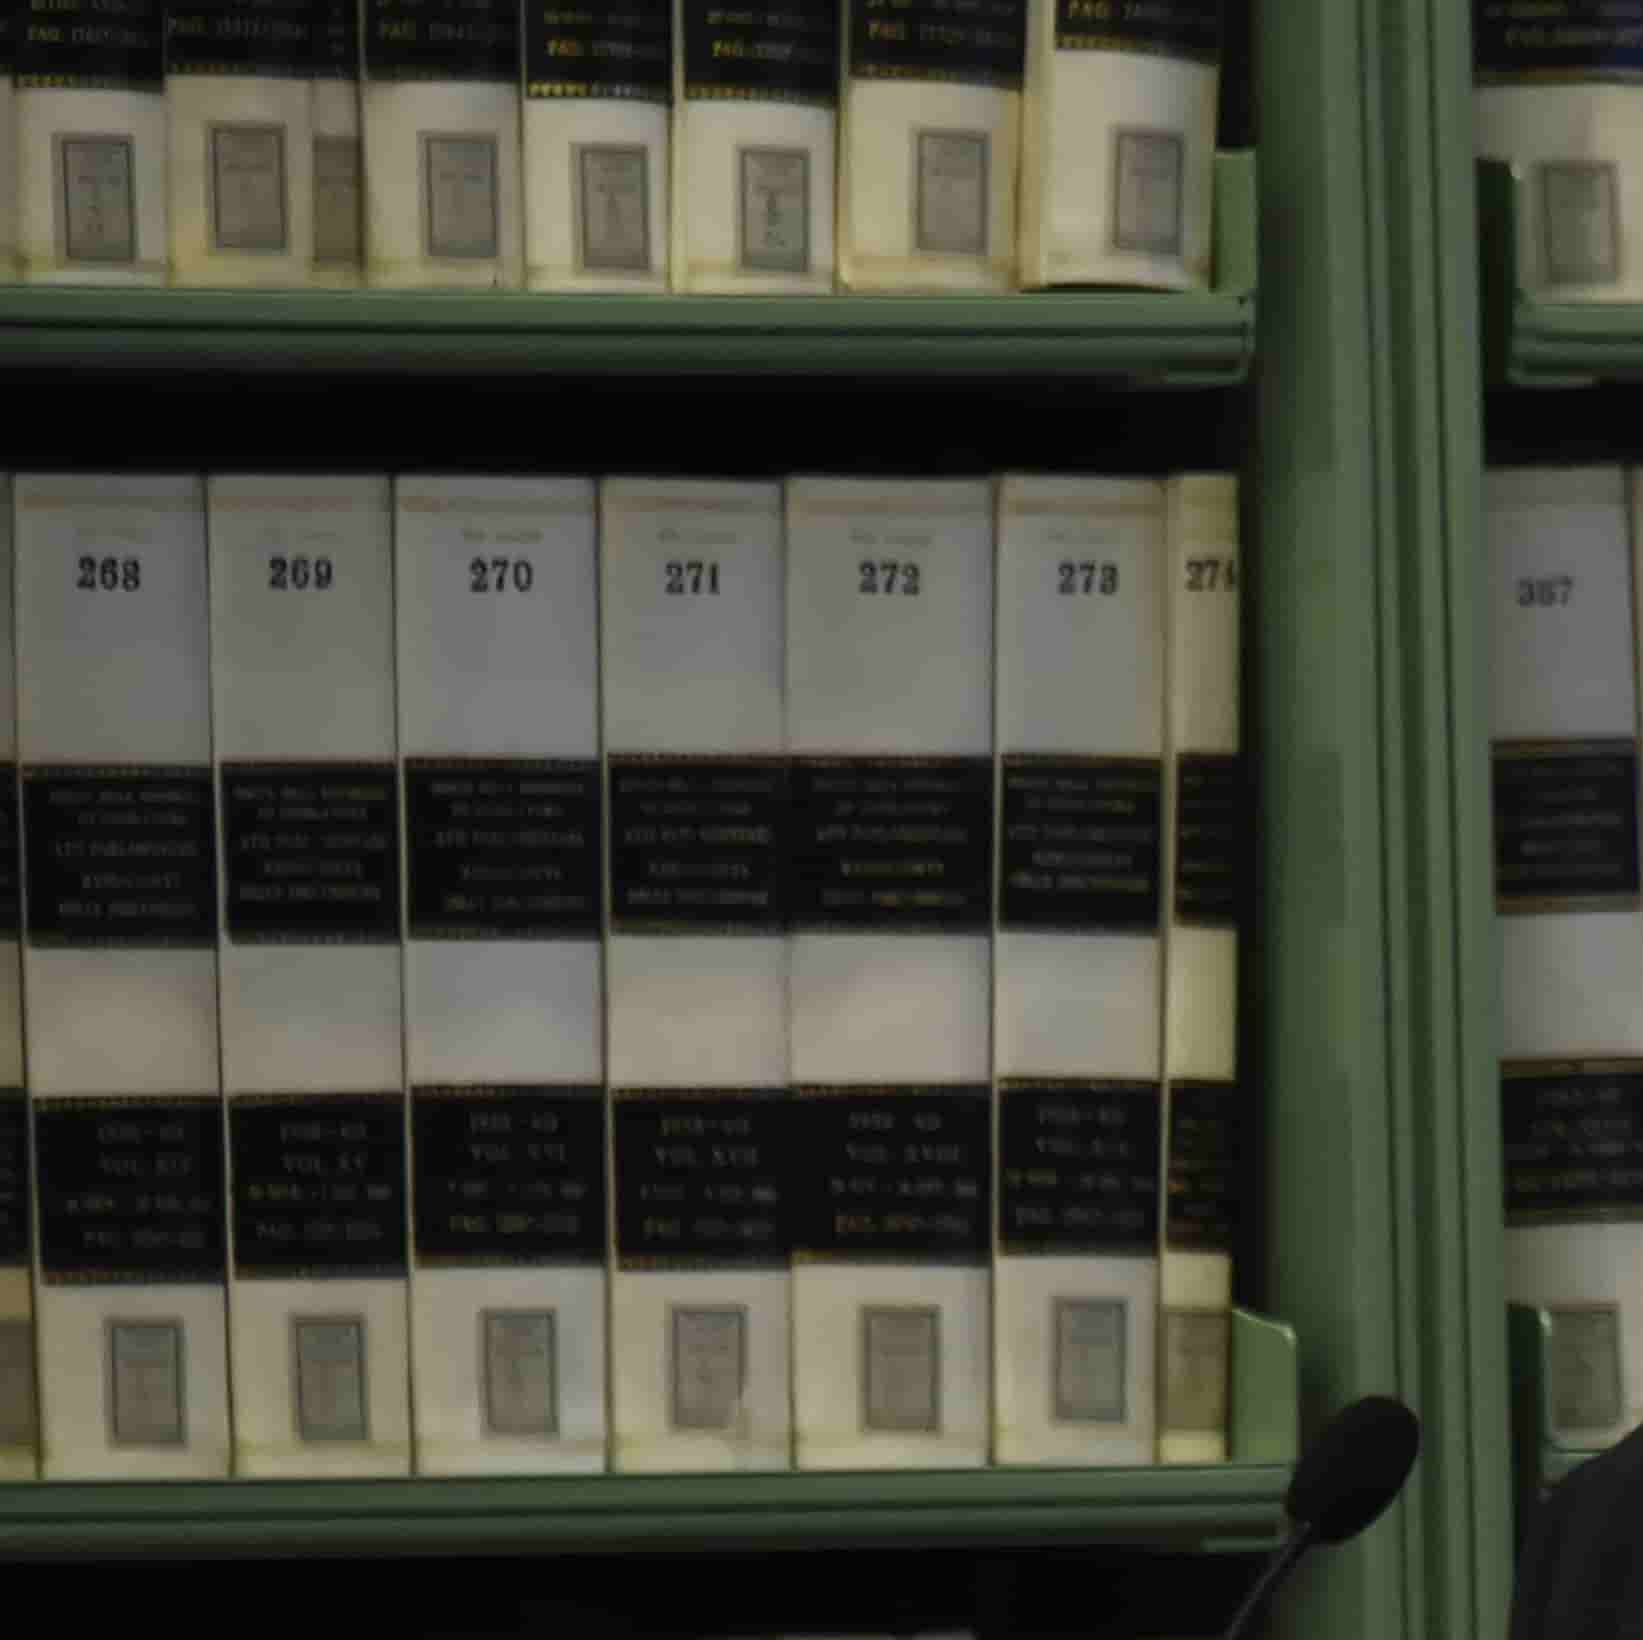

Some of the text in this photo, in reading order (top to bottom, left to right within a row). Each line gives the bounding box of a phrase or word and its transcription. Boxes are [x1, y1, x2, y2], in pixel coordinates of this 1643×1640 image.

[76, 557, 142, 592] 268
[268, 556, 334, 591] 269
[468, 557, 535, 593] 270
[664, 560, 721, 596] 271
[859, 560, 920, 597] 272
[1057, 561, 1119, 597] 273
